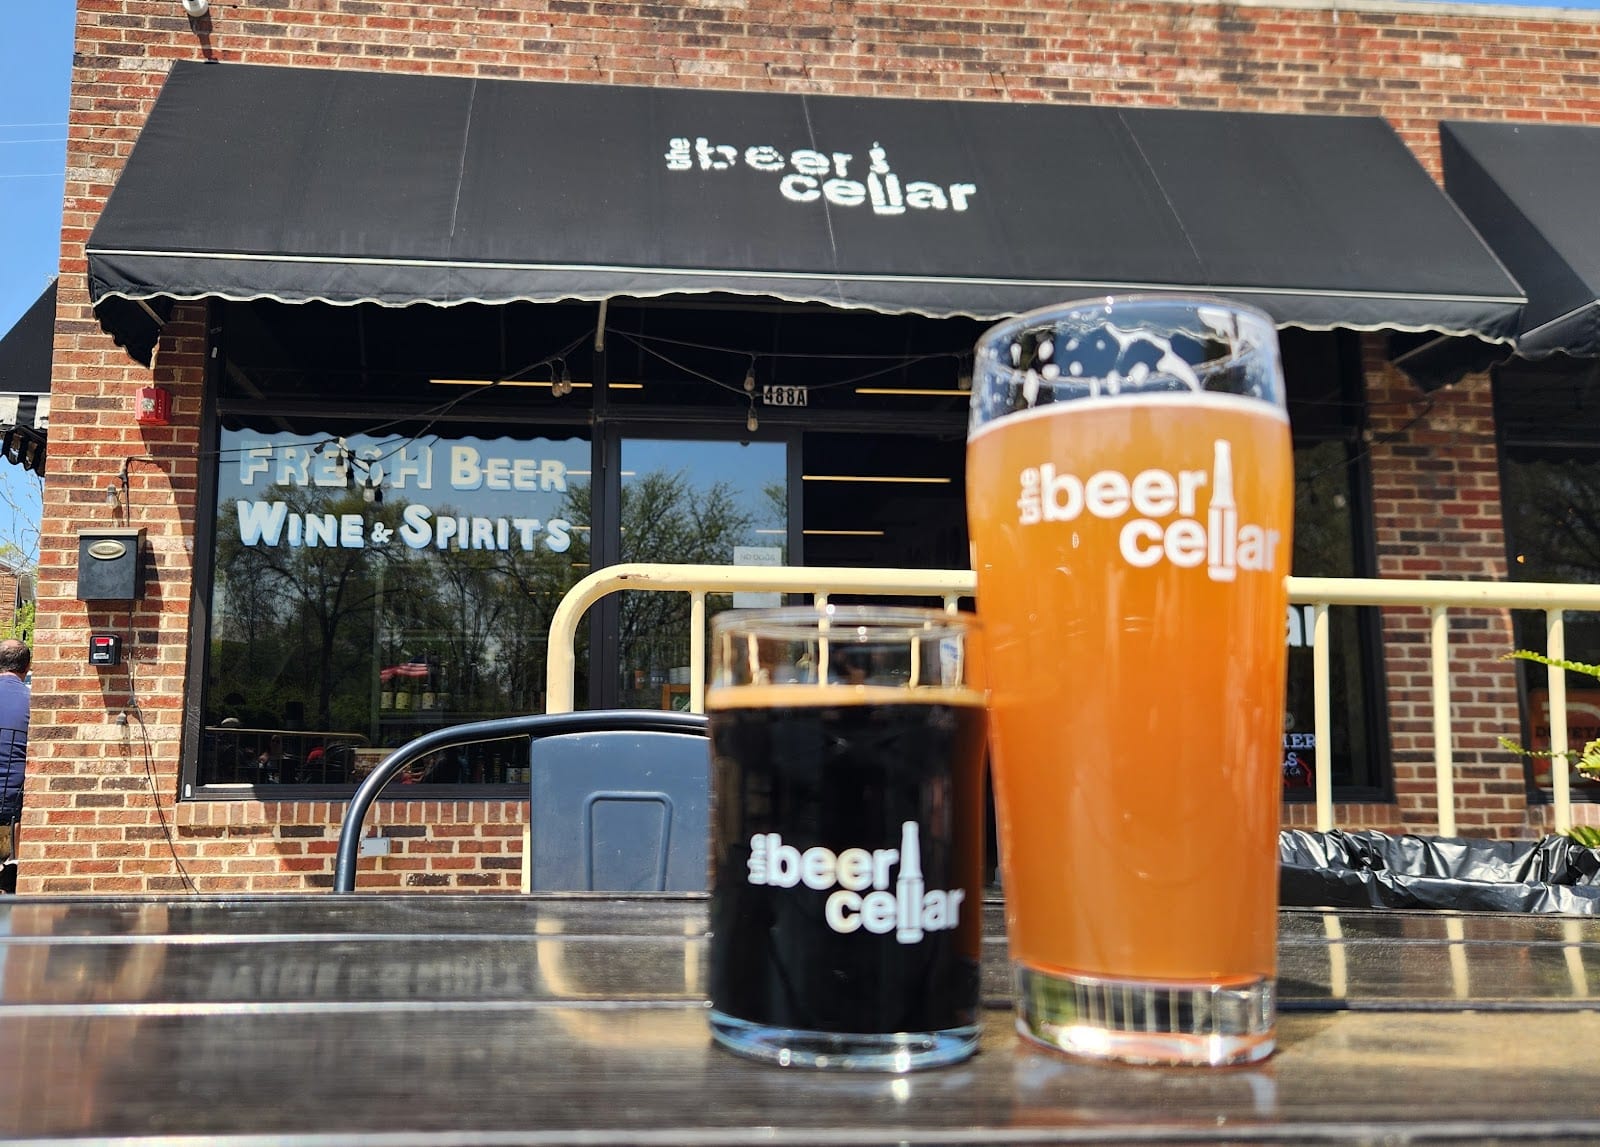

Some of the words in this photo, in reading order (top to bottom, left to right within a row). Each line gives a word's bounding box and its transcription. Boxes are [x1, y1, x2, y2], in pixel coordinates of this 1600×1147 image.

[695, 137, 852, 177] beer
[780, 171, 976, 214] cellar
[764, 387, 806, 406] 488A
[239, 440, 434, 490] FRESH
[450, 445, 568, 492] BEER
[1040, 462, 1208, 522] beer
[236, 500, 365, 548] WINE
[370, 521, 394, 545] &
[399, 503, 572, 553] SPIRITS
[1119, 502, 1281, 582] cellar
[766, 833, 900, 891] beer
[825, 878, 966, 945] cellar
